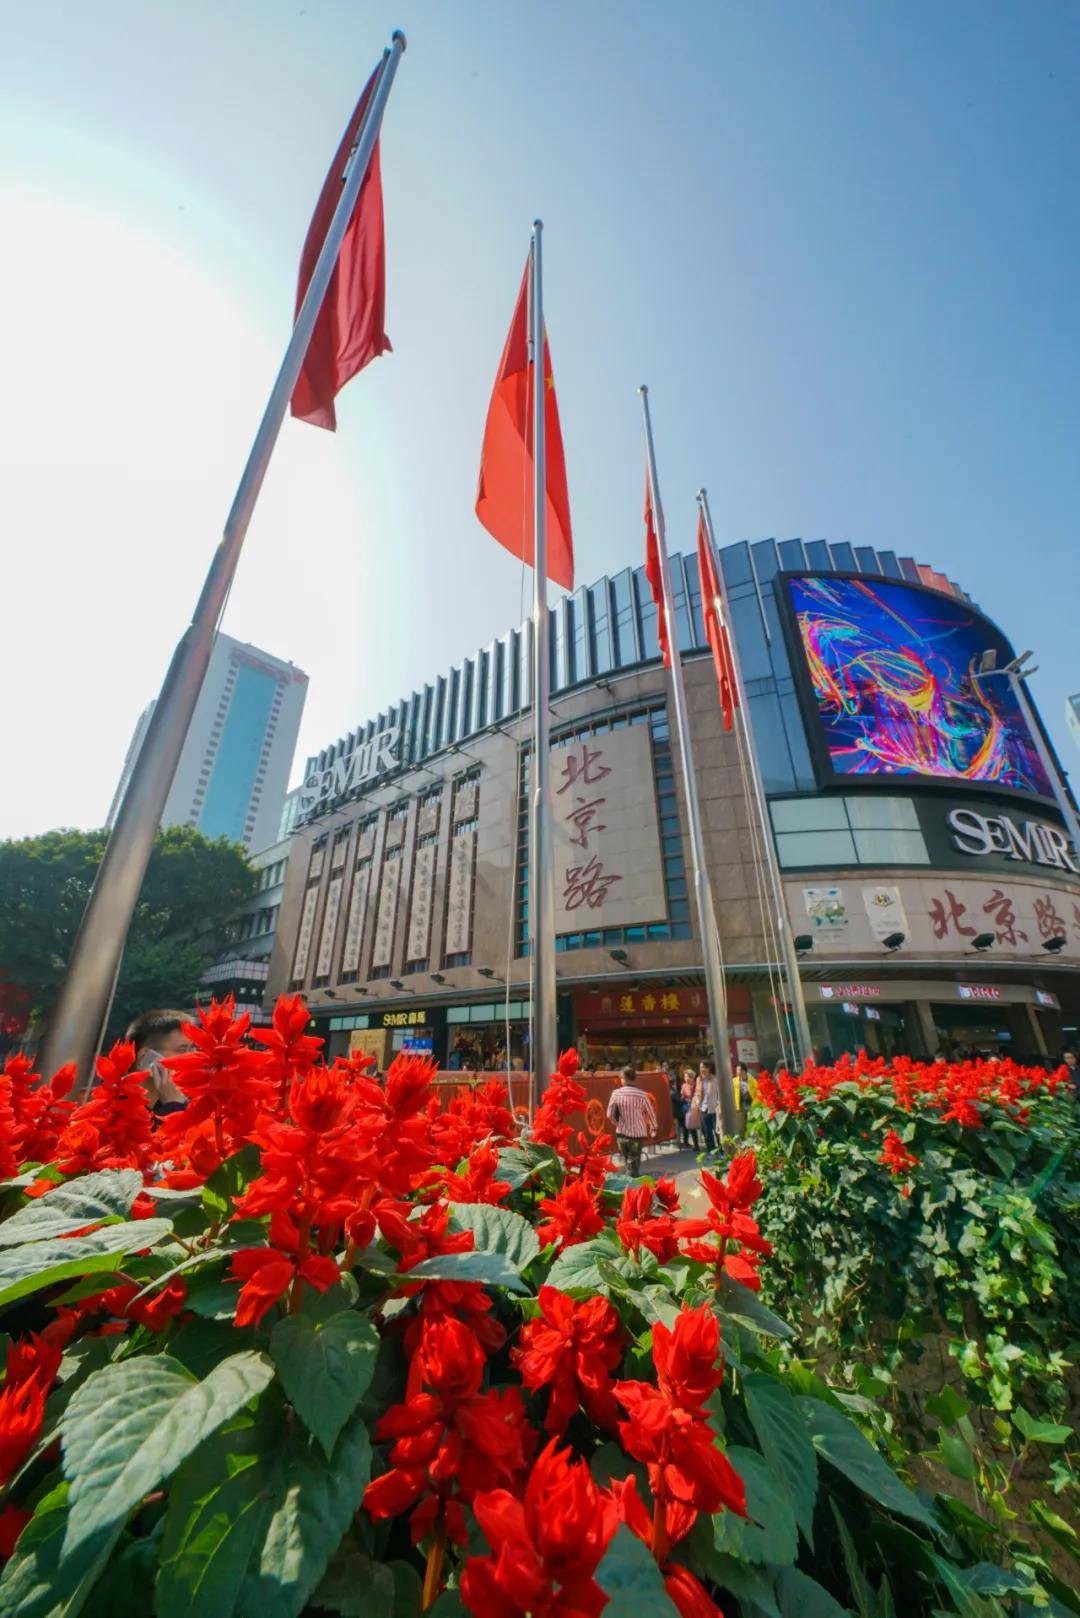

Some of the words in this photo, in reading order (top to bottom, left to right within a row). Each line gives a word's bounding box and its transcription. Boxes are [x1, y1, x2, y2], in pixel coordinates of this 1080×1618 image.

[556, 744, 623, 911] 北京路
[948, 809, 1080, 873] SEMIR
